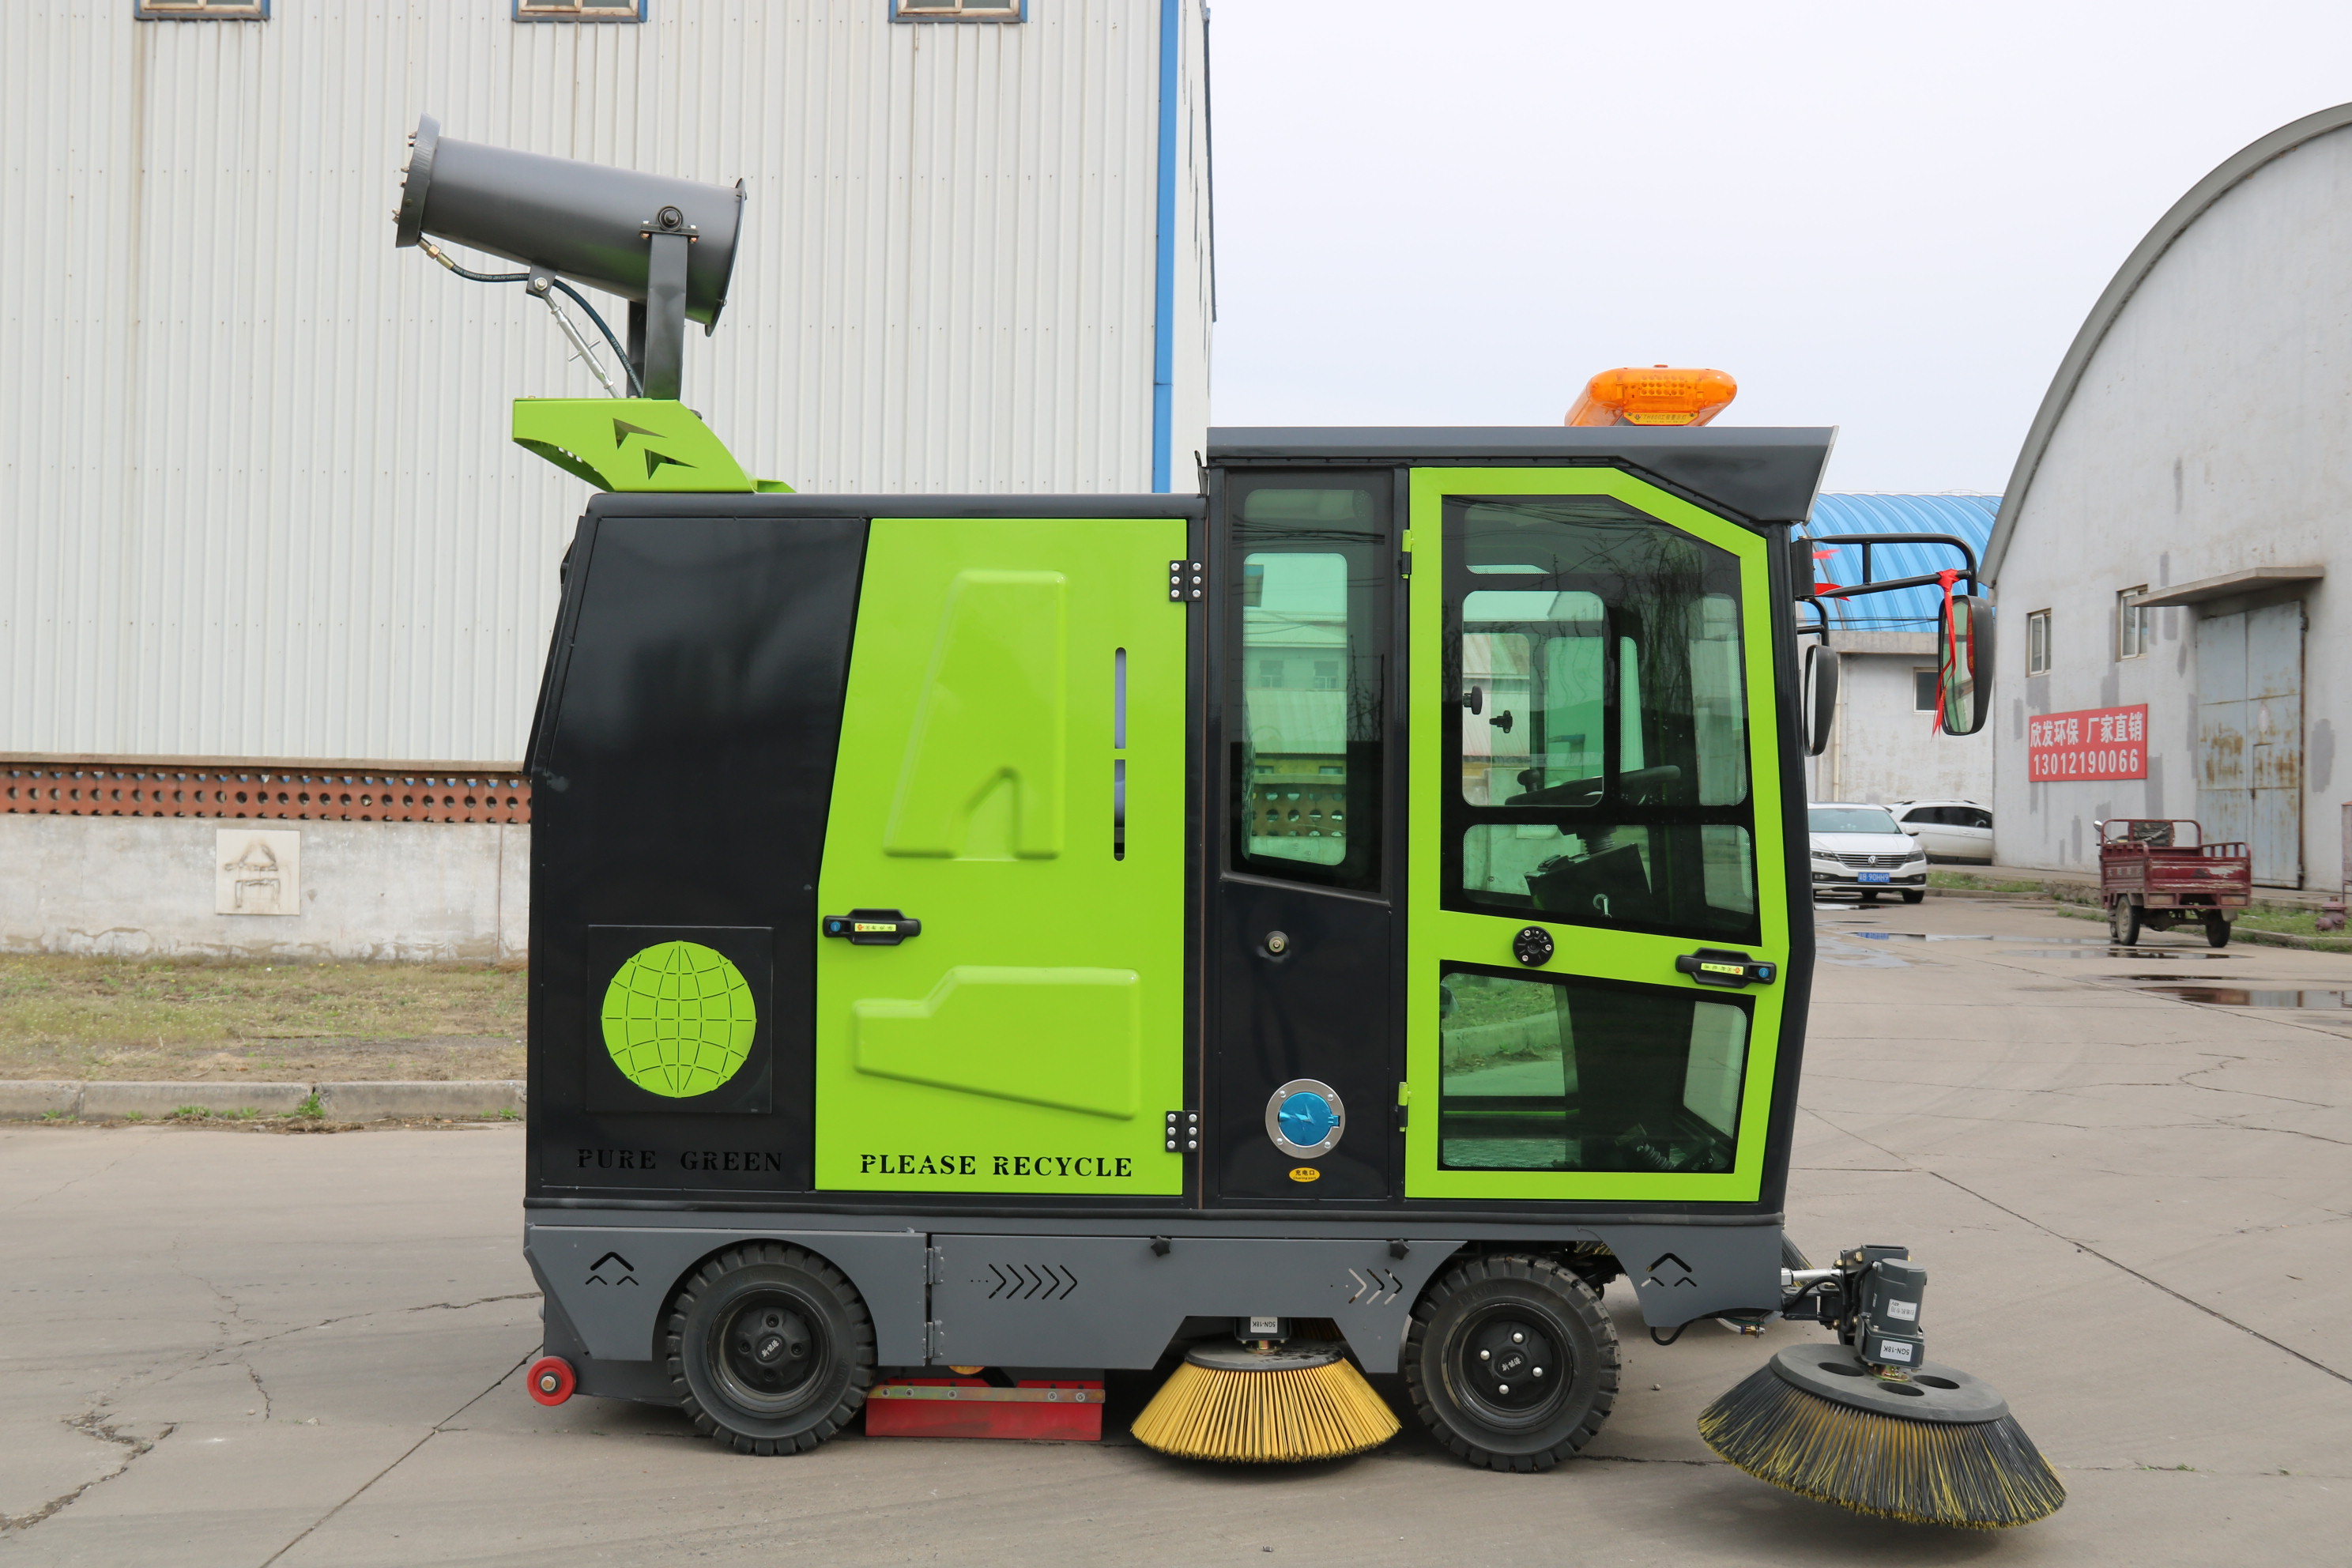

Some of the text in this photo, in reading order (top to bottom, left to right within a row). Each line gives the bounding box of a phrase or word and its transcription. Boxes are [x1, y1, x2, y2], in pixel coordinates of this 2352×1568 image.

[2030, 712, 2143, 748] 欣发环保 厂家直销
[2034, 748, 2139, 775] 13012190066
[578, 1148, 782, 1171] PURE GREEN
[860, 1154, 1132, 1177] PLEASE RECYCLE
[1883, 1345, 1909, 1355] 5GN-18K
